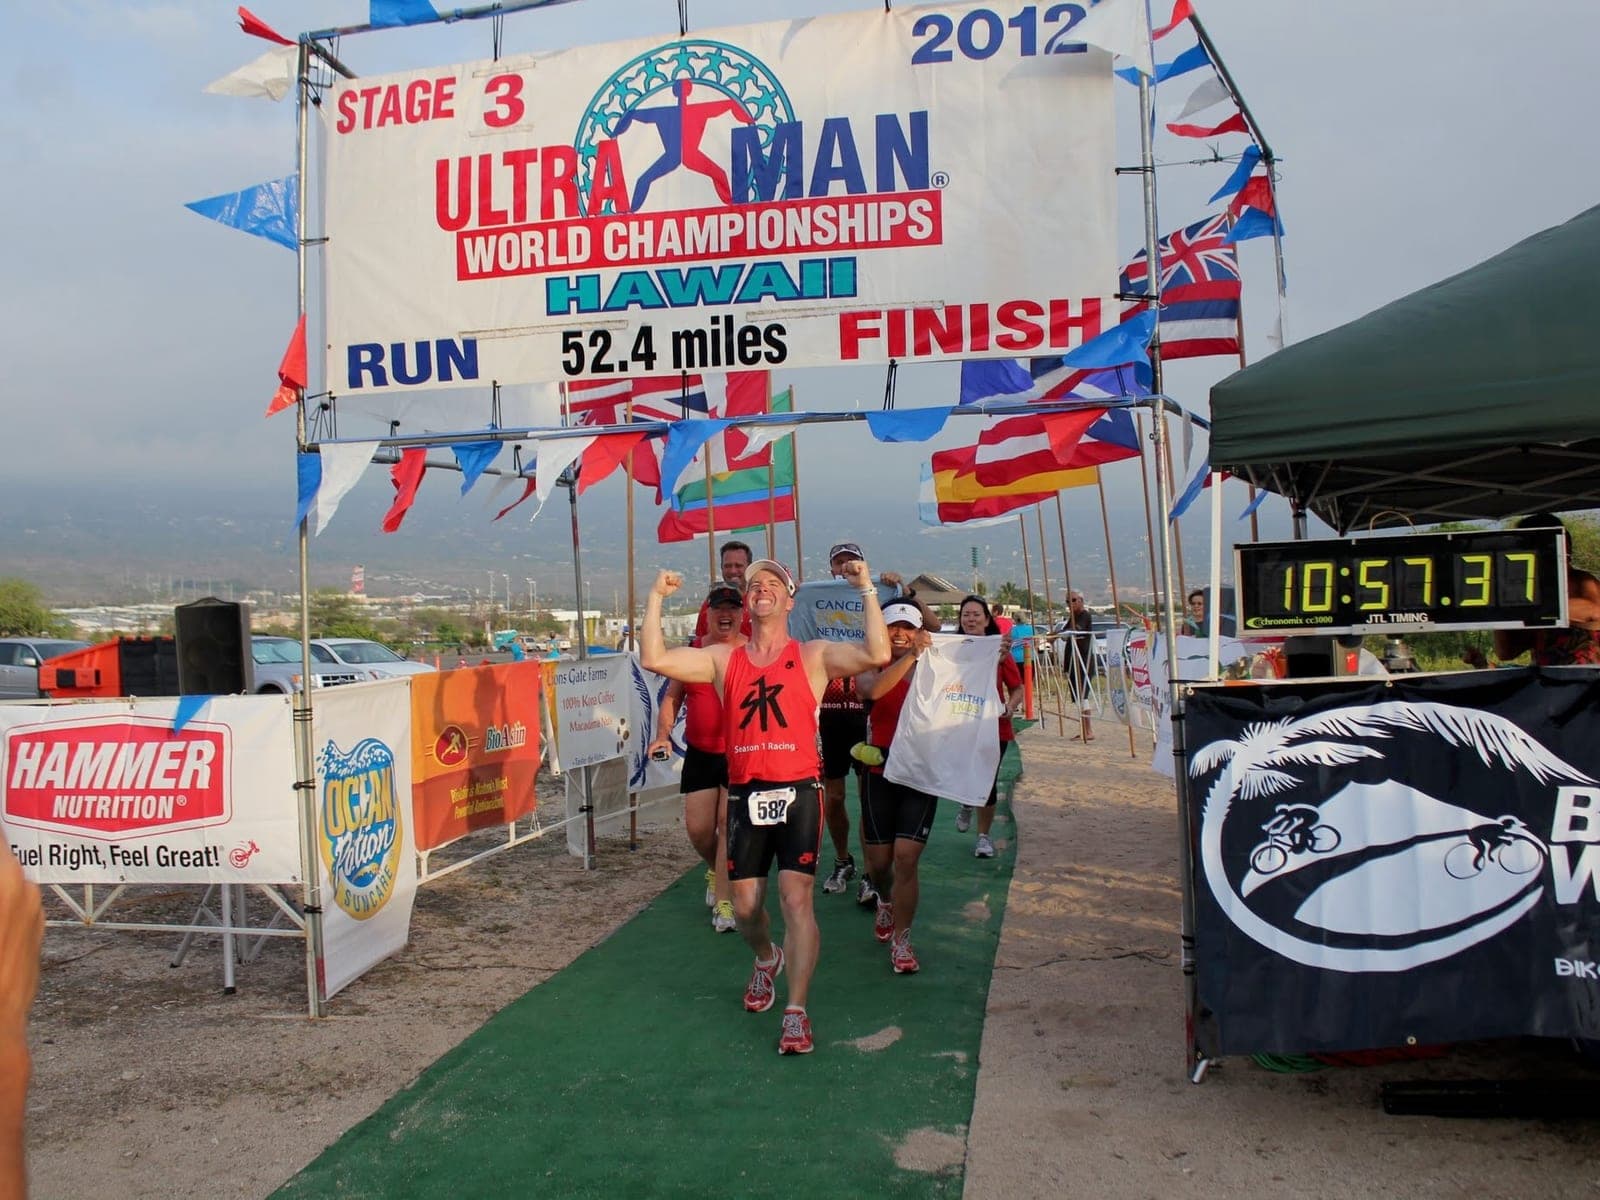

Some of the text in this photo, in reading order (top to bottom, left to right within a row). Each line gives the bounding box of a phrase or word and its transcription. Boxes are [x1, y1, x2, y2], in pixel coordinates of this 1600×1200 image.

[911, 4, 1088, 65] 2012
[336, 74, 525, 135] STAGE 3
[435, 111, 931, 232] ULTRA MAN
[463, 199, 934, 275] WORLD CHAMPIONSHIPS
[545, 256, 858, 317] HAWAII
[562, 315, 788, 376] 52.4 miles
[839, 297, 1102, 361] FINISH
[347, 338, 480, 389] RUN
[1284, 553, 1537, 612] 10:57.37
[1305, 615, 1333, 625] cc3000
[1366, 612, 1430, 624] JTL TIMING
[568, 667, 587, 685] Gate
[588, 666, 608, 681] Farms
[944, 692, 986, 706] HEALTHY
[10, 739, 216, 790] HAMMER
[734, 741, 796, 754] Season 1 Racing
[53, 794, 175, 819] NUTRITION
[326, 767, 393, 837] OCEAN
[757, 799, 788, 820] 582
[49, 843, 107, 871] Right,
[110, 845, 150, 867] Feel
[156, 845, 220, 868] Great!
[335, 824, 394, 889] Potion
[343, 865, 394, 913] SUNCARE
[1554, 957, 1600, 979] BIK
